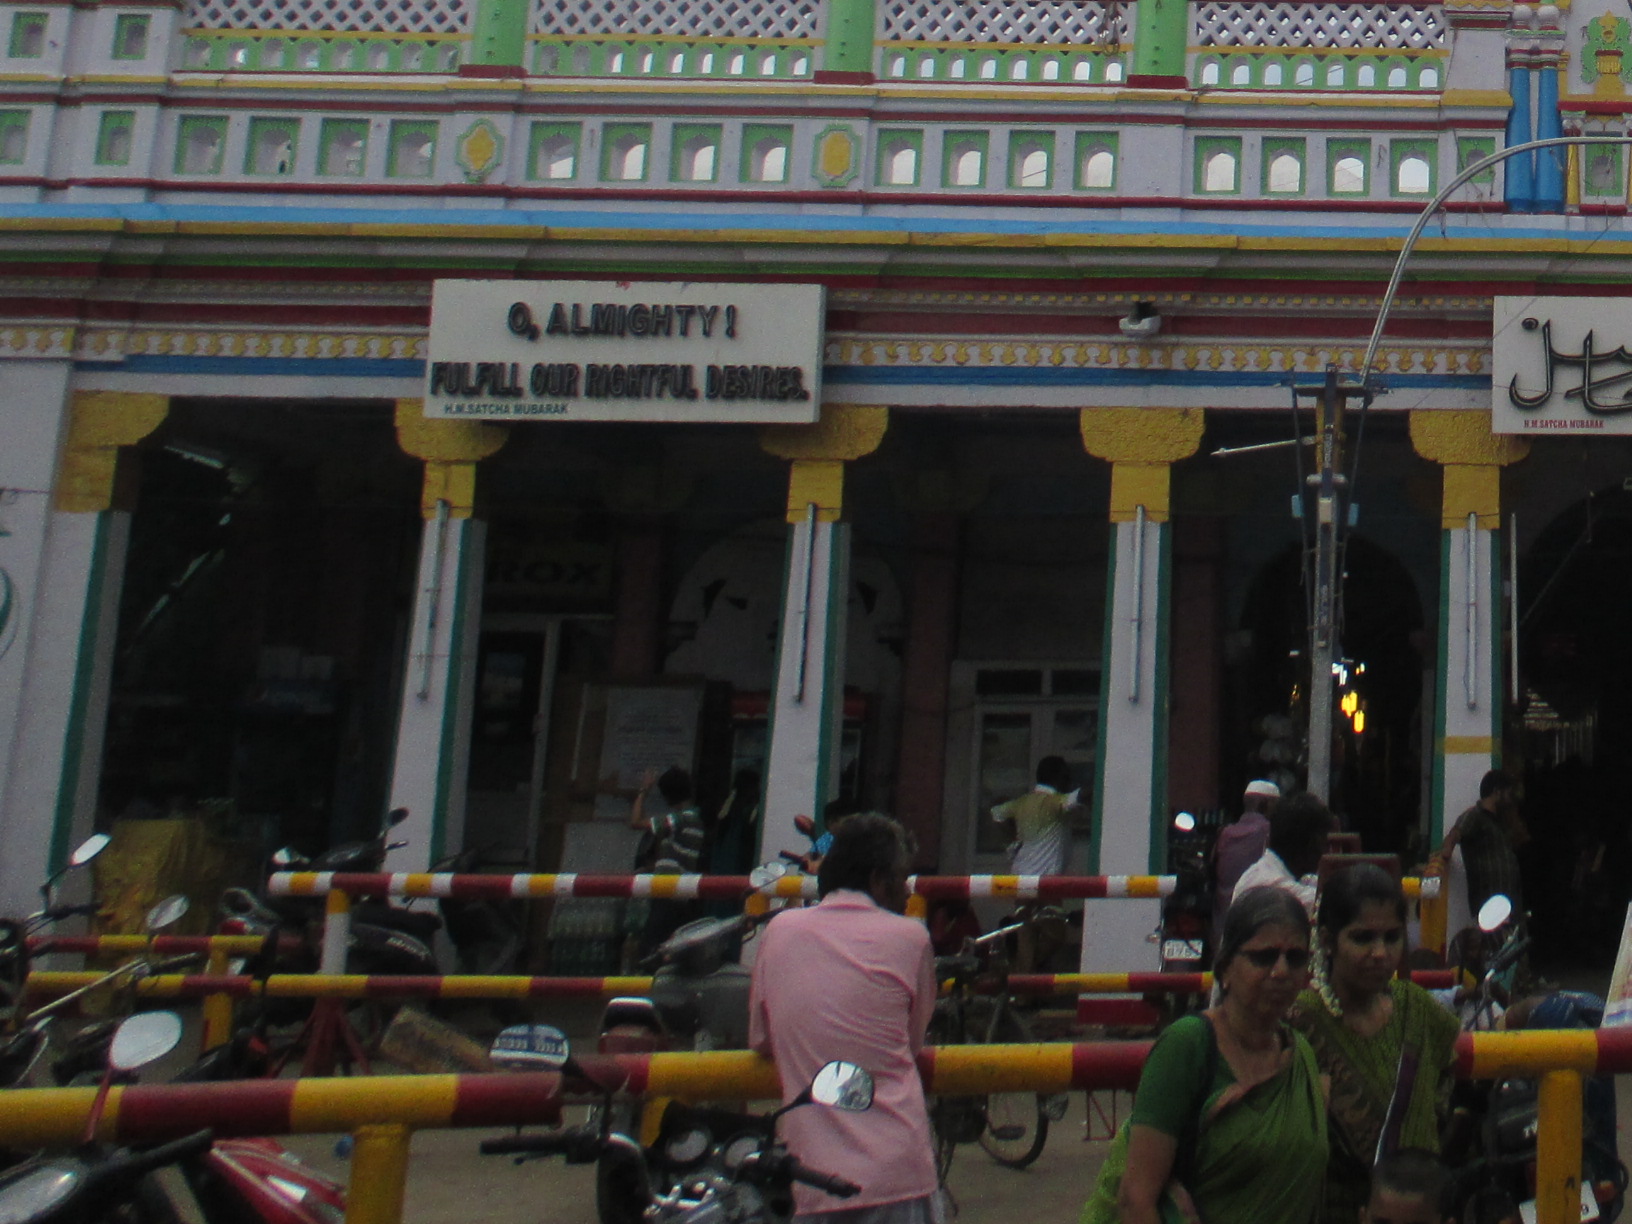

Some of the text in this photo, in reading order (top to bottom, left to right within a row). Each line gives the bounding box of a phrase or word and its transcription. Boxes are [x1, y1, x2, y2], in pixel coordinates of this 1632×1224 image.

[430, 362, 810, 401] FULFILL OUR RIGHTFUL DESIRES.
[513, 403, 568, 415] MUBARAK
[1570, 419, 1604, 429] MUBARAK
